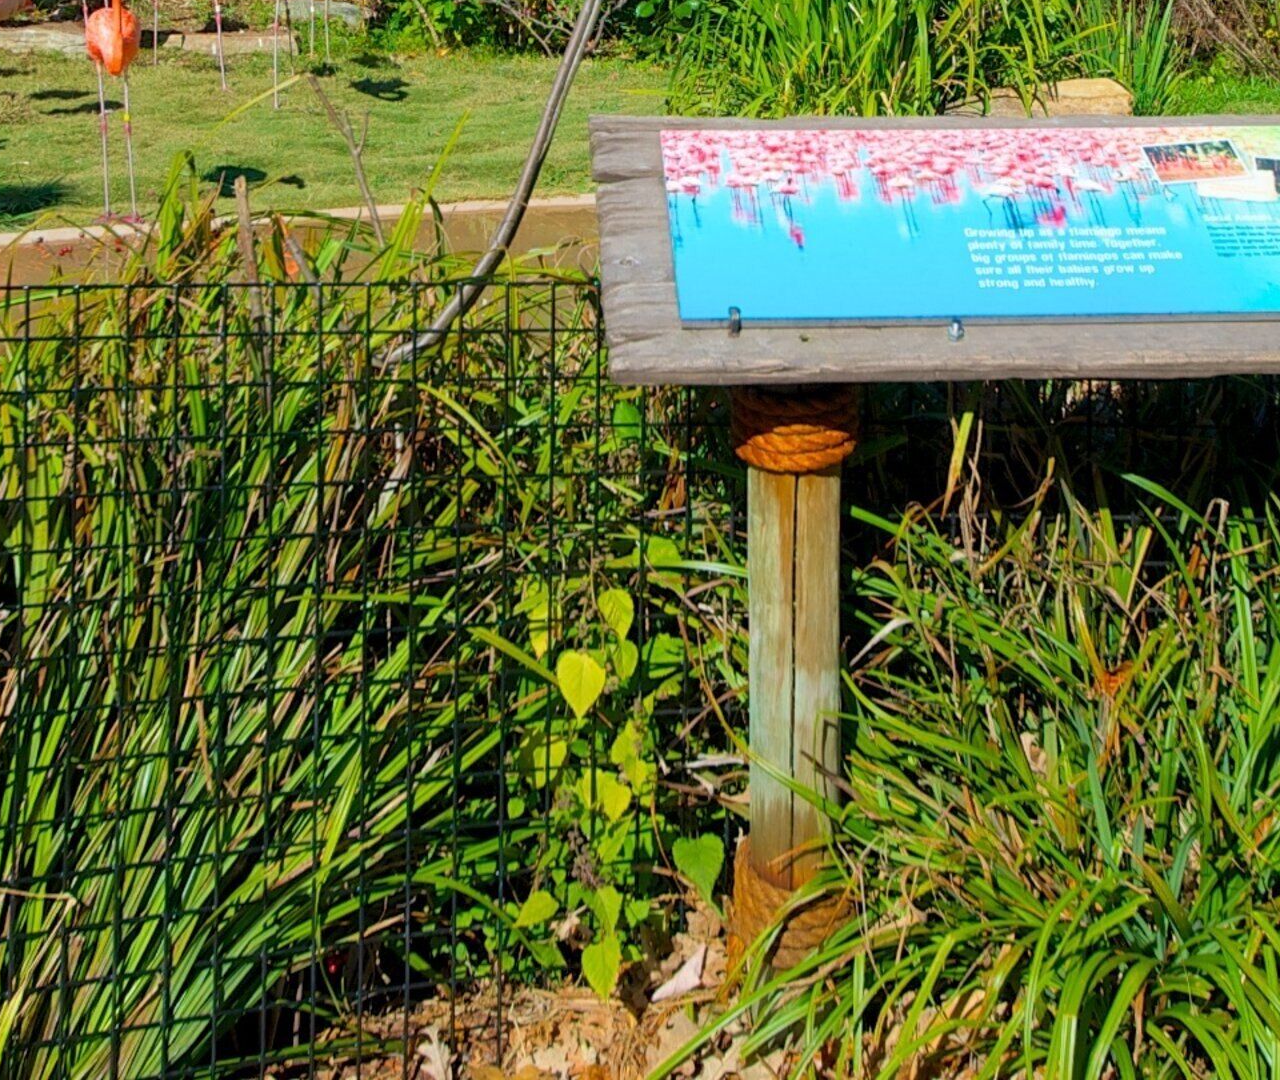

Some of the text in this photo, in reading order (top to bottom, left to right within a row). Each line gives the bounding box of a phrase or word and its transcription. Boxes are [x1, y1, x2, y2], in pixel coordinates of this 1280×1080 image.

[964, 228, 1016, 239] Growing
[1019, 228, 1035, 238] up
[1068, 227, 1122, 238] flamingo
[1125, 227, 1166, 236] means
[968, 240, 1006, 252] plenty
[1010, 240, 1023, 250] of
[1027, 240, 1065, 251] family
[970, 250, 1183, 264] big groups of flamingos can make
[974, 264, 1155, 275] sure all their babies grow up
[978, 278, 1019, 290] strong
[1023, 278, 1046, 288] and
